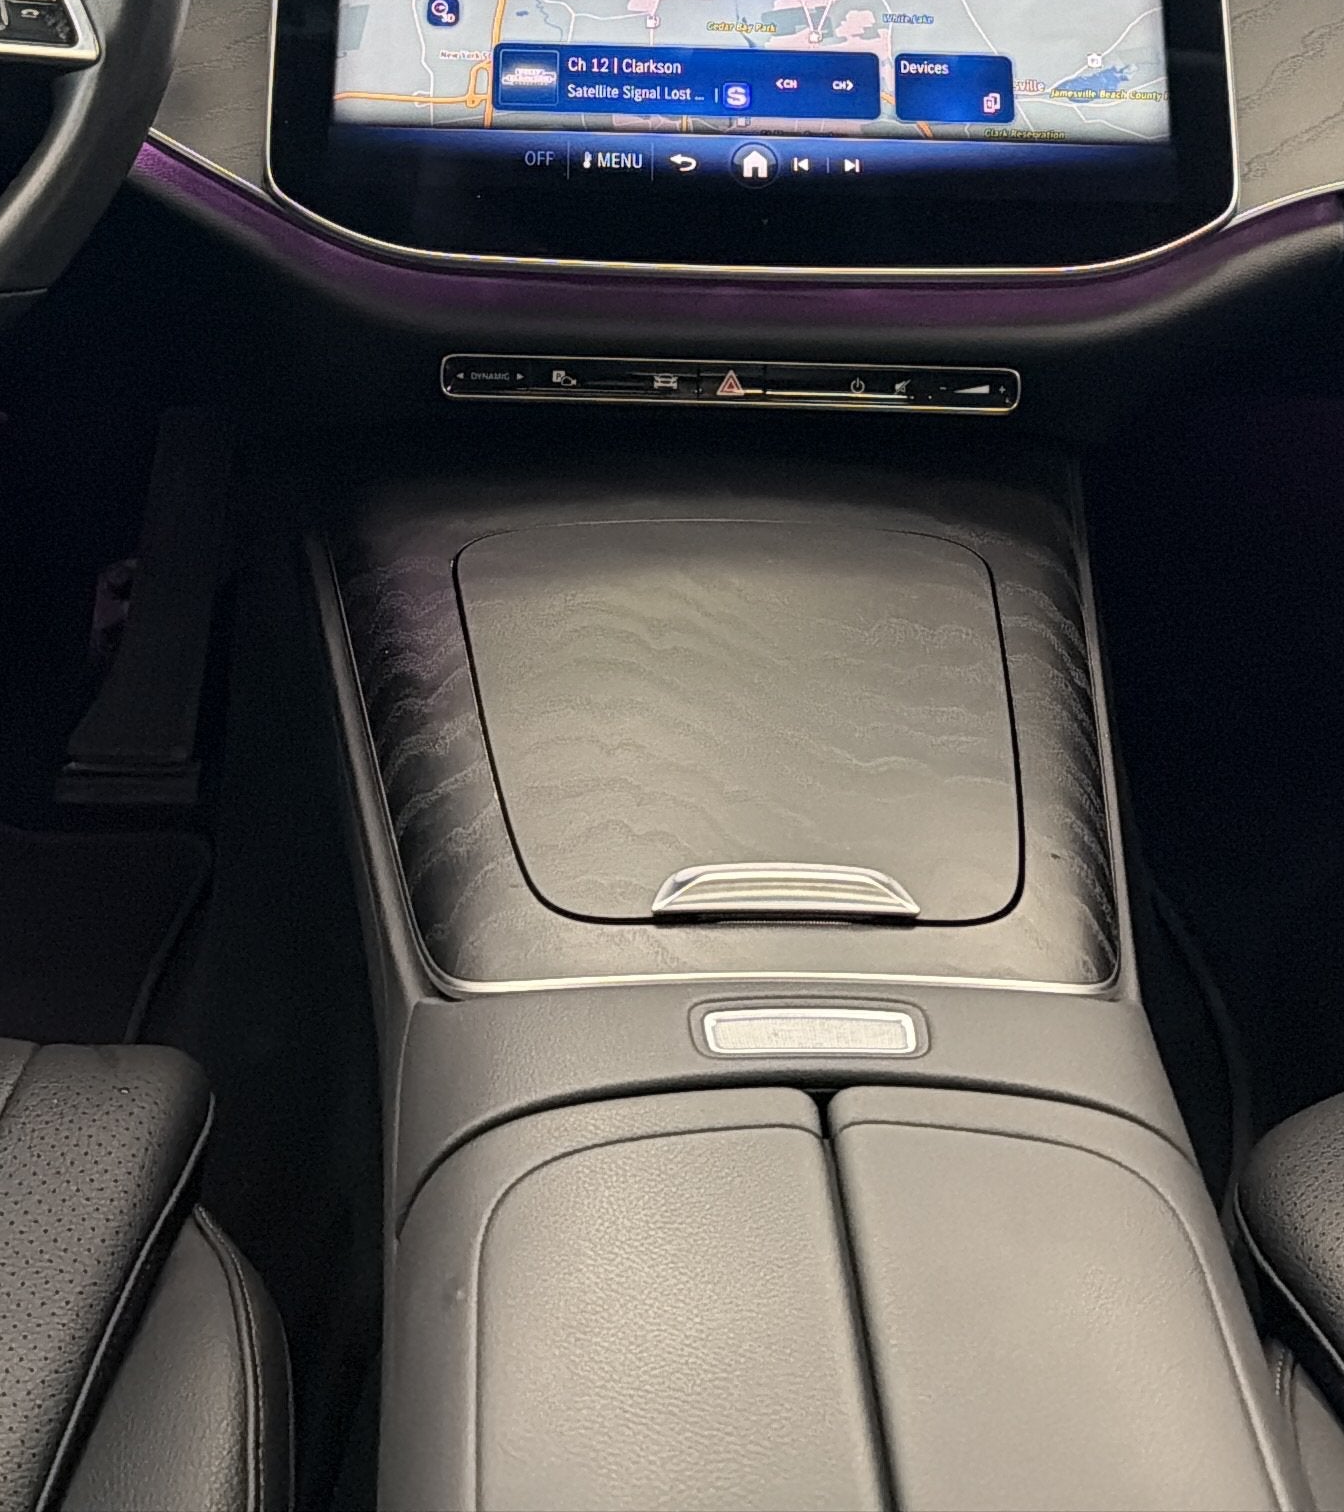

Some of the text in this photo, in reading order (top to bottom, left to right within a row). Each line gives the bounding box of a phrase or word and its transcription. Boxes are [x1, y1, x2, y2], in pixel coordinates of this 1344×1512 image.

[706, 21, 777, 34] Cedar Bay Park
[567, 58, 587, 74] Ch
[591, 58, 609, 74] 12
[622, 58, 682, 75] Clarkson
[899, 60, 949, 75] Devices
[567, 83, 619, 99] Satellite
[622, 84, 661, 102] Signal
[664, 85, 692, 101] Lost
[1049, 89, 1097, 100] Jamesville
[1099, 90, 1128, 100] Beach
[1130, 91, 1162, 102] County
[984, 127, 1066, 140] Clark Reservation
[525, 150, 555, 167] OFF
[596, 151, 644, 170] MENU
[470, 371, 511, 382] DYNAMIC
